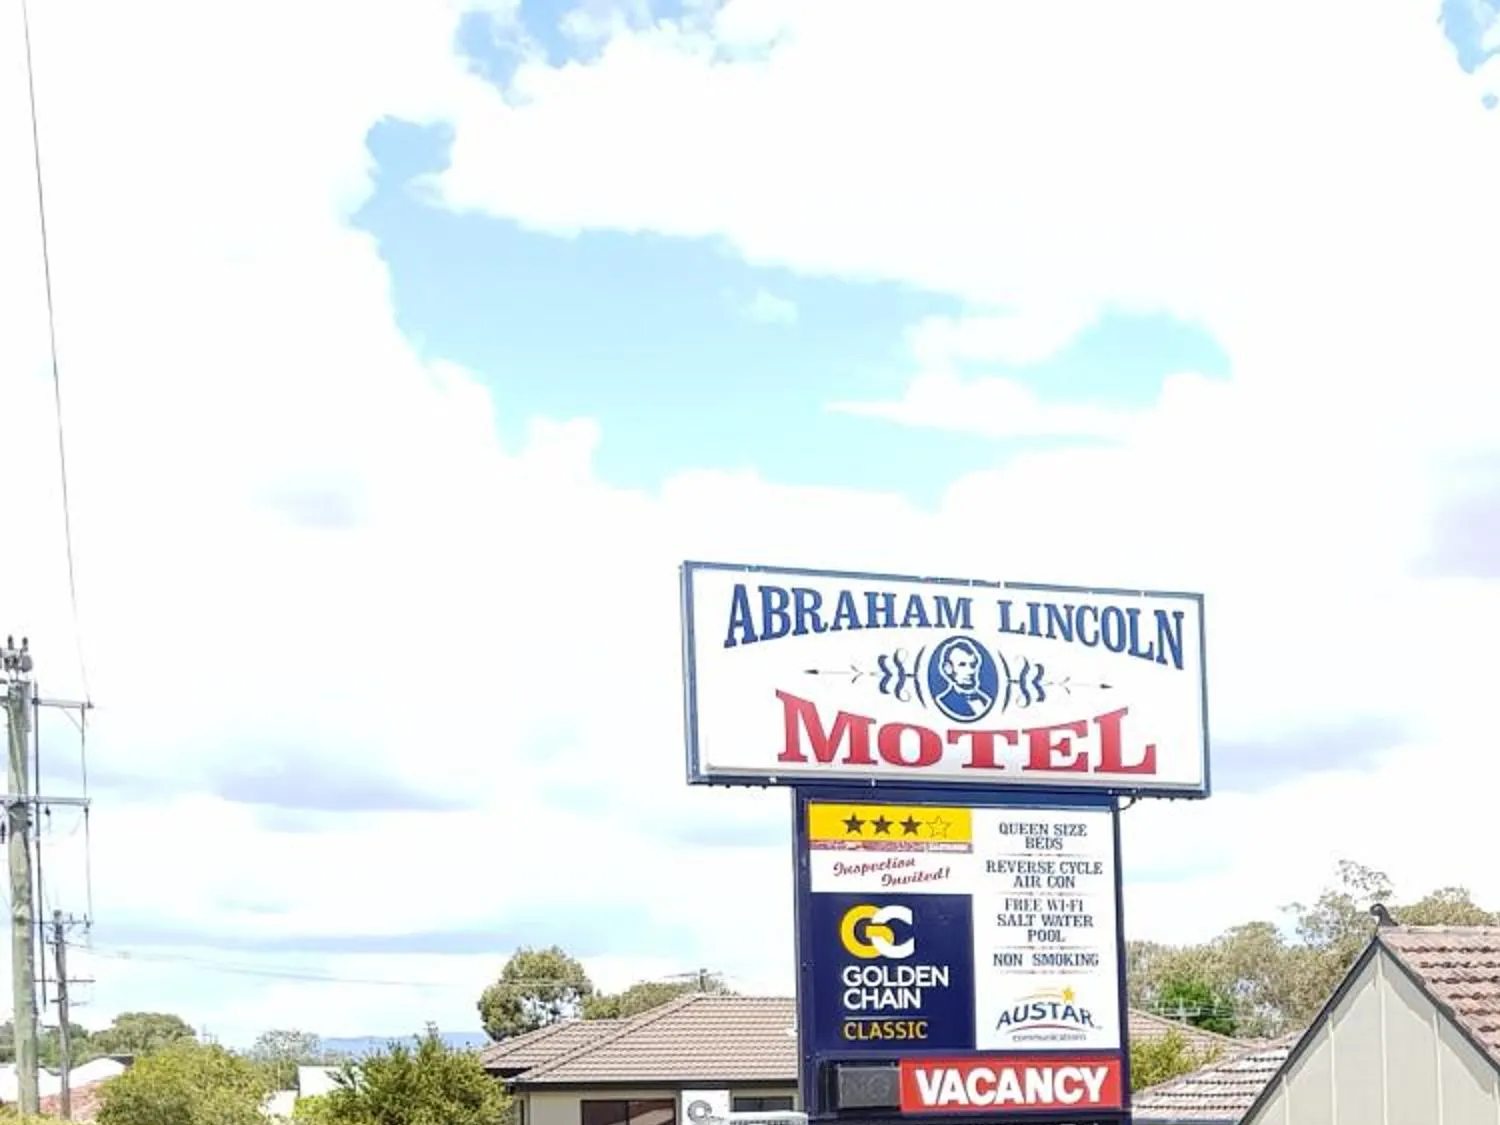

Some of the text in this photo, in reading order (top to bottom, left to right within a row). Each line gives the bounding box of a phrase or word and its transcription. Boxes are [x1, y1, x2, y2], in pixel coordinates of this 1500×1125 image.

[723, 583, 1185, 670] ABRAHAM LINCOLN
[775, 688, 1158, 775] MOTEL
[998, 822, 1088, 837] QUEEN SIZE
[1025, 837, 1064, 850] BEDS
[833, 856, 916, 877] Inspection
[985, 859, 1104, 875] REVERSE CYCLE
[1013, 875, 1076, 889] AIR CON
[1004, 897, 1043, 912] FREE
[997, 913, 1094, 927] SALT WATER
[1027, 929, 1067, 943] POOL
[993, 953, 1099, 967] NON SMOKING
[843, 965, 949, 988] GOLDEN
[843, 988, 921, 1010] CHAIN
[996, 1001, 1095, 1031] AUSTAR
[844, 1021, 929, 1040] CLASSIC
[914, 1066, 1109, 1106] VACANCY
